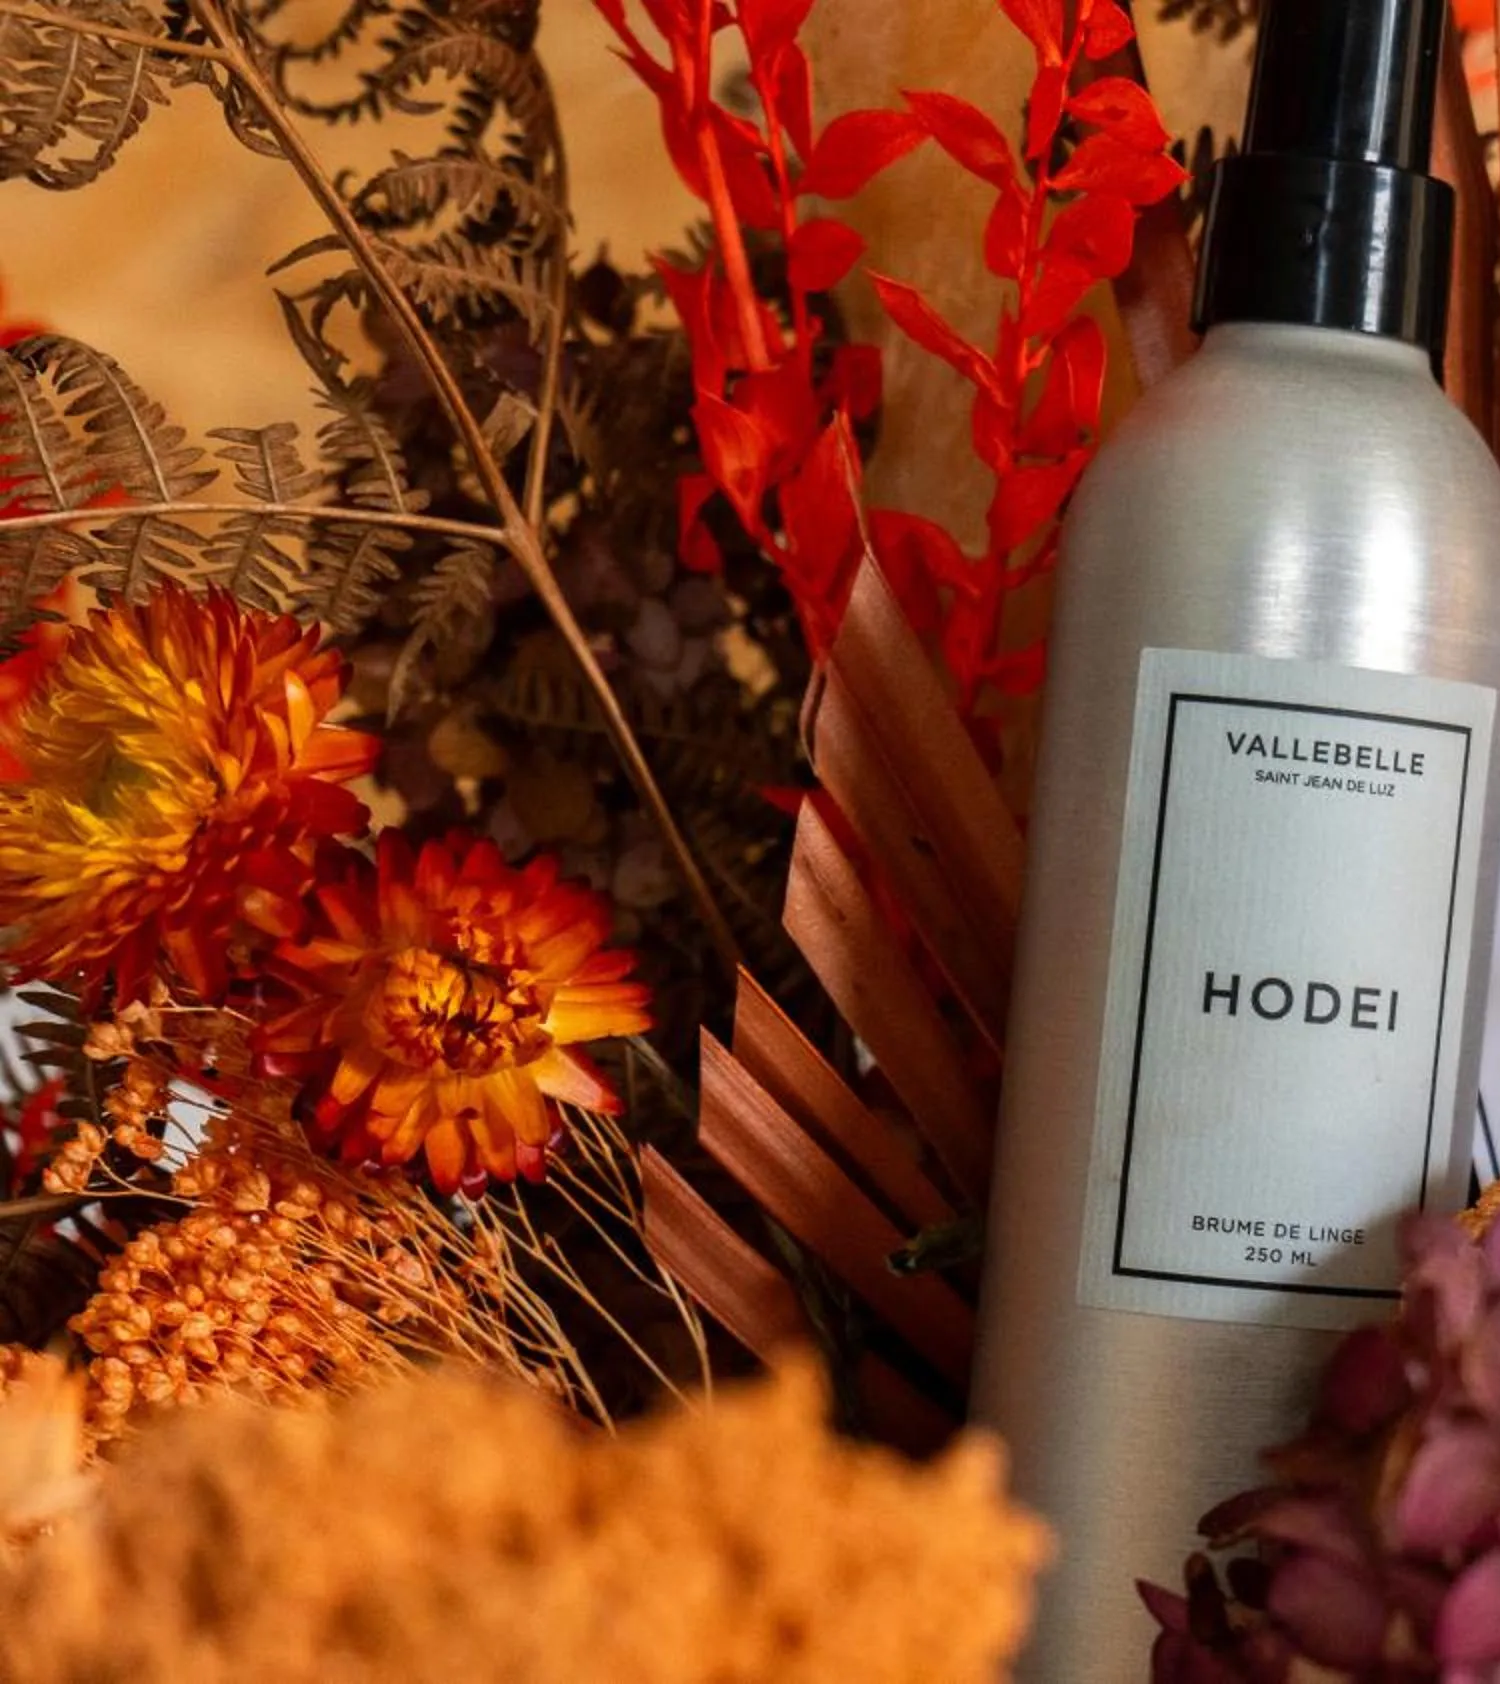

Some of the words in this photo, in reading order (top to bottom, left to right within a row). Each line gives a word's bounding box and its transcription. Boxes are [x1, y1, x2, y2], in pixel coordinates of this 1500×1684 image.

[1226, 731, 1425, 775] VALLEBELLE
[1255, 769, 1299, 785] SAINT
[1304, 775, 1342, 791] JEAN
[1347, 779, 1365, 793] DE
[1369, 783, 1396, 798] LUZ
[1202, 971, 1399, 1032] HODEI
[1192, 1215, 1265, 1237] BRUME
[1274, 1224, 1301, 1240] DE
[1309, 1226, 1365, 1245] LINGE
[1245, 1246, 1283, 1264] 250
[1291, 1250, 1317, 1267] ML
